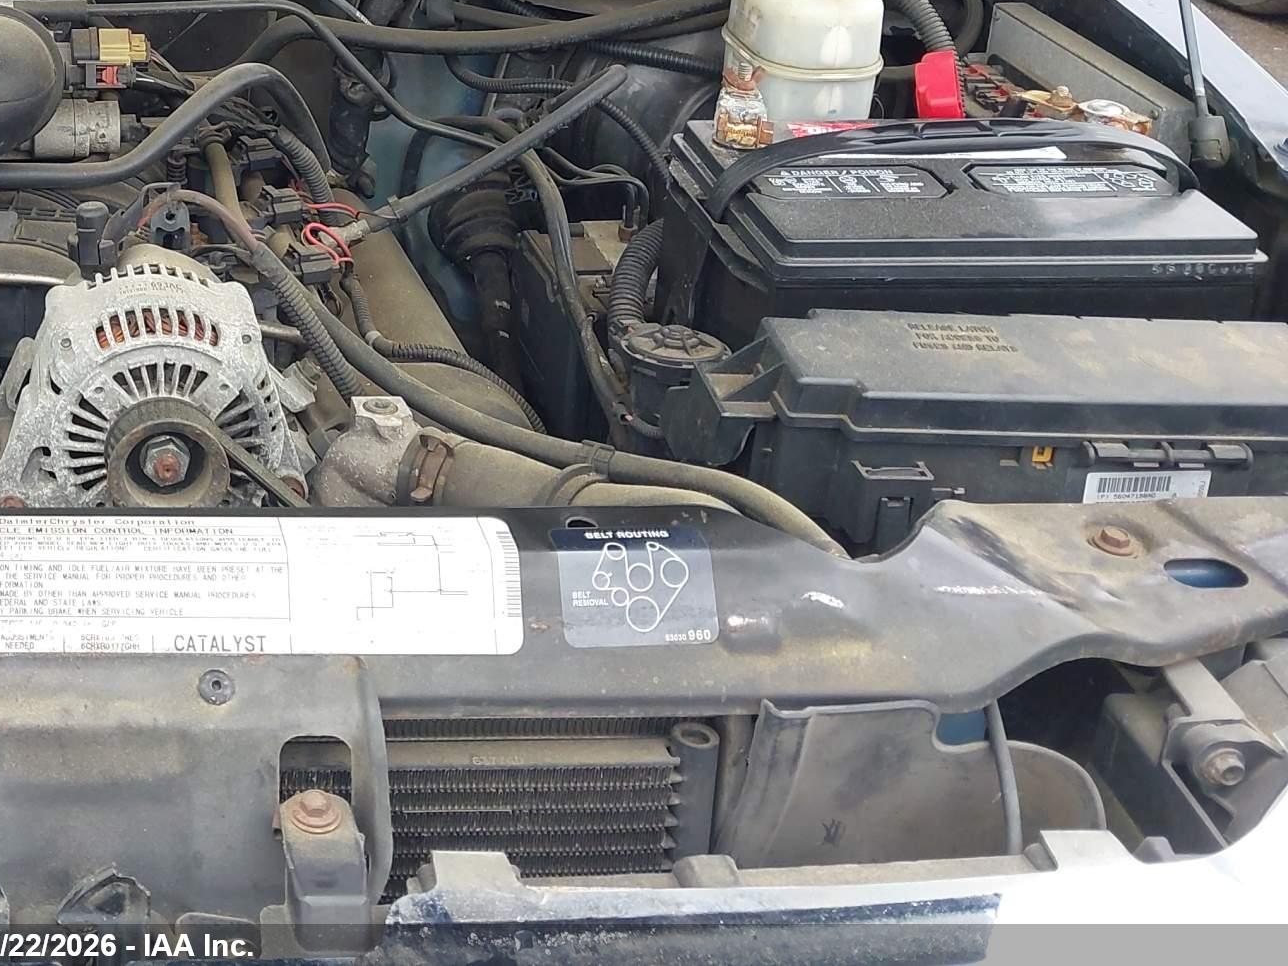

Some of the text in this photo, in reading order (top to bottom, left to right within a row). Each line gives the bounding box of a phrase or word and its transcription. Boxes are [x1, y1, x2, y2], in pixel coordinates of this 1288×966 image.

[0, 518, 195, 527] DaimlerChrysler Corporation
[617, 530, 669, 538] ROUTING
[572, 591, 591, 599] BELT
[5, 642, 34, 650] NEEDED
[174, 635, 266, 652] CATALYST
